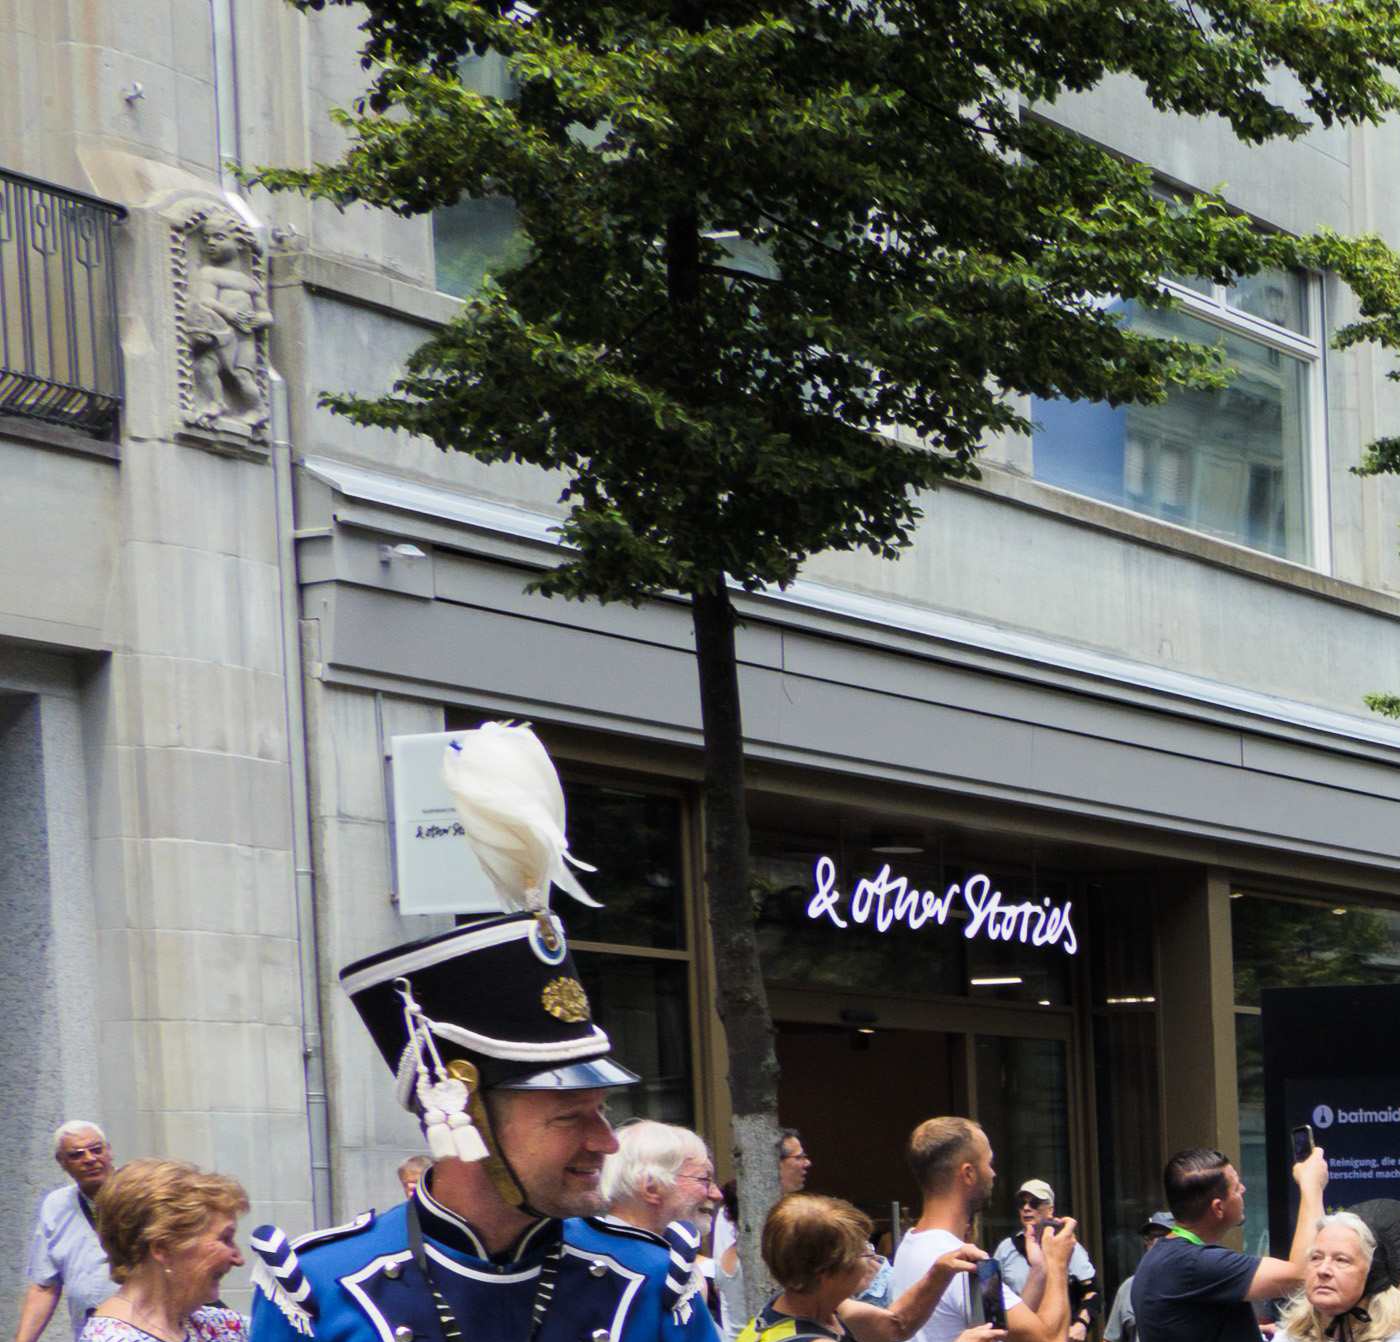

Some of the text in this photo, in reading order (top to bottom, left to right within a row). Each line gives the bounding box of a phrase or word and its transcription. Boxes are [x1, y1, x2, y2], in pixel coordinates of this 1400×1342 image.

[807, 856, 1077, 955] & other Stories
[1329, 1157, 1380, 1169] Reinigung,
[1381, 1156, 1396, 1166] die
[1329, 1169, 1374, 1180] terschied
